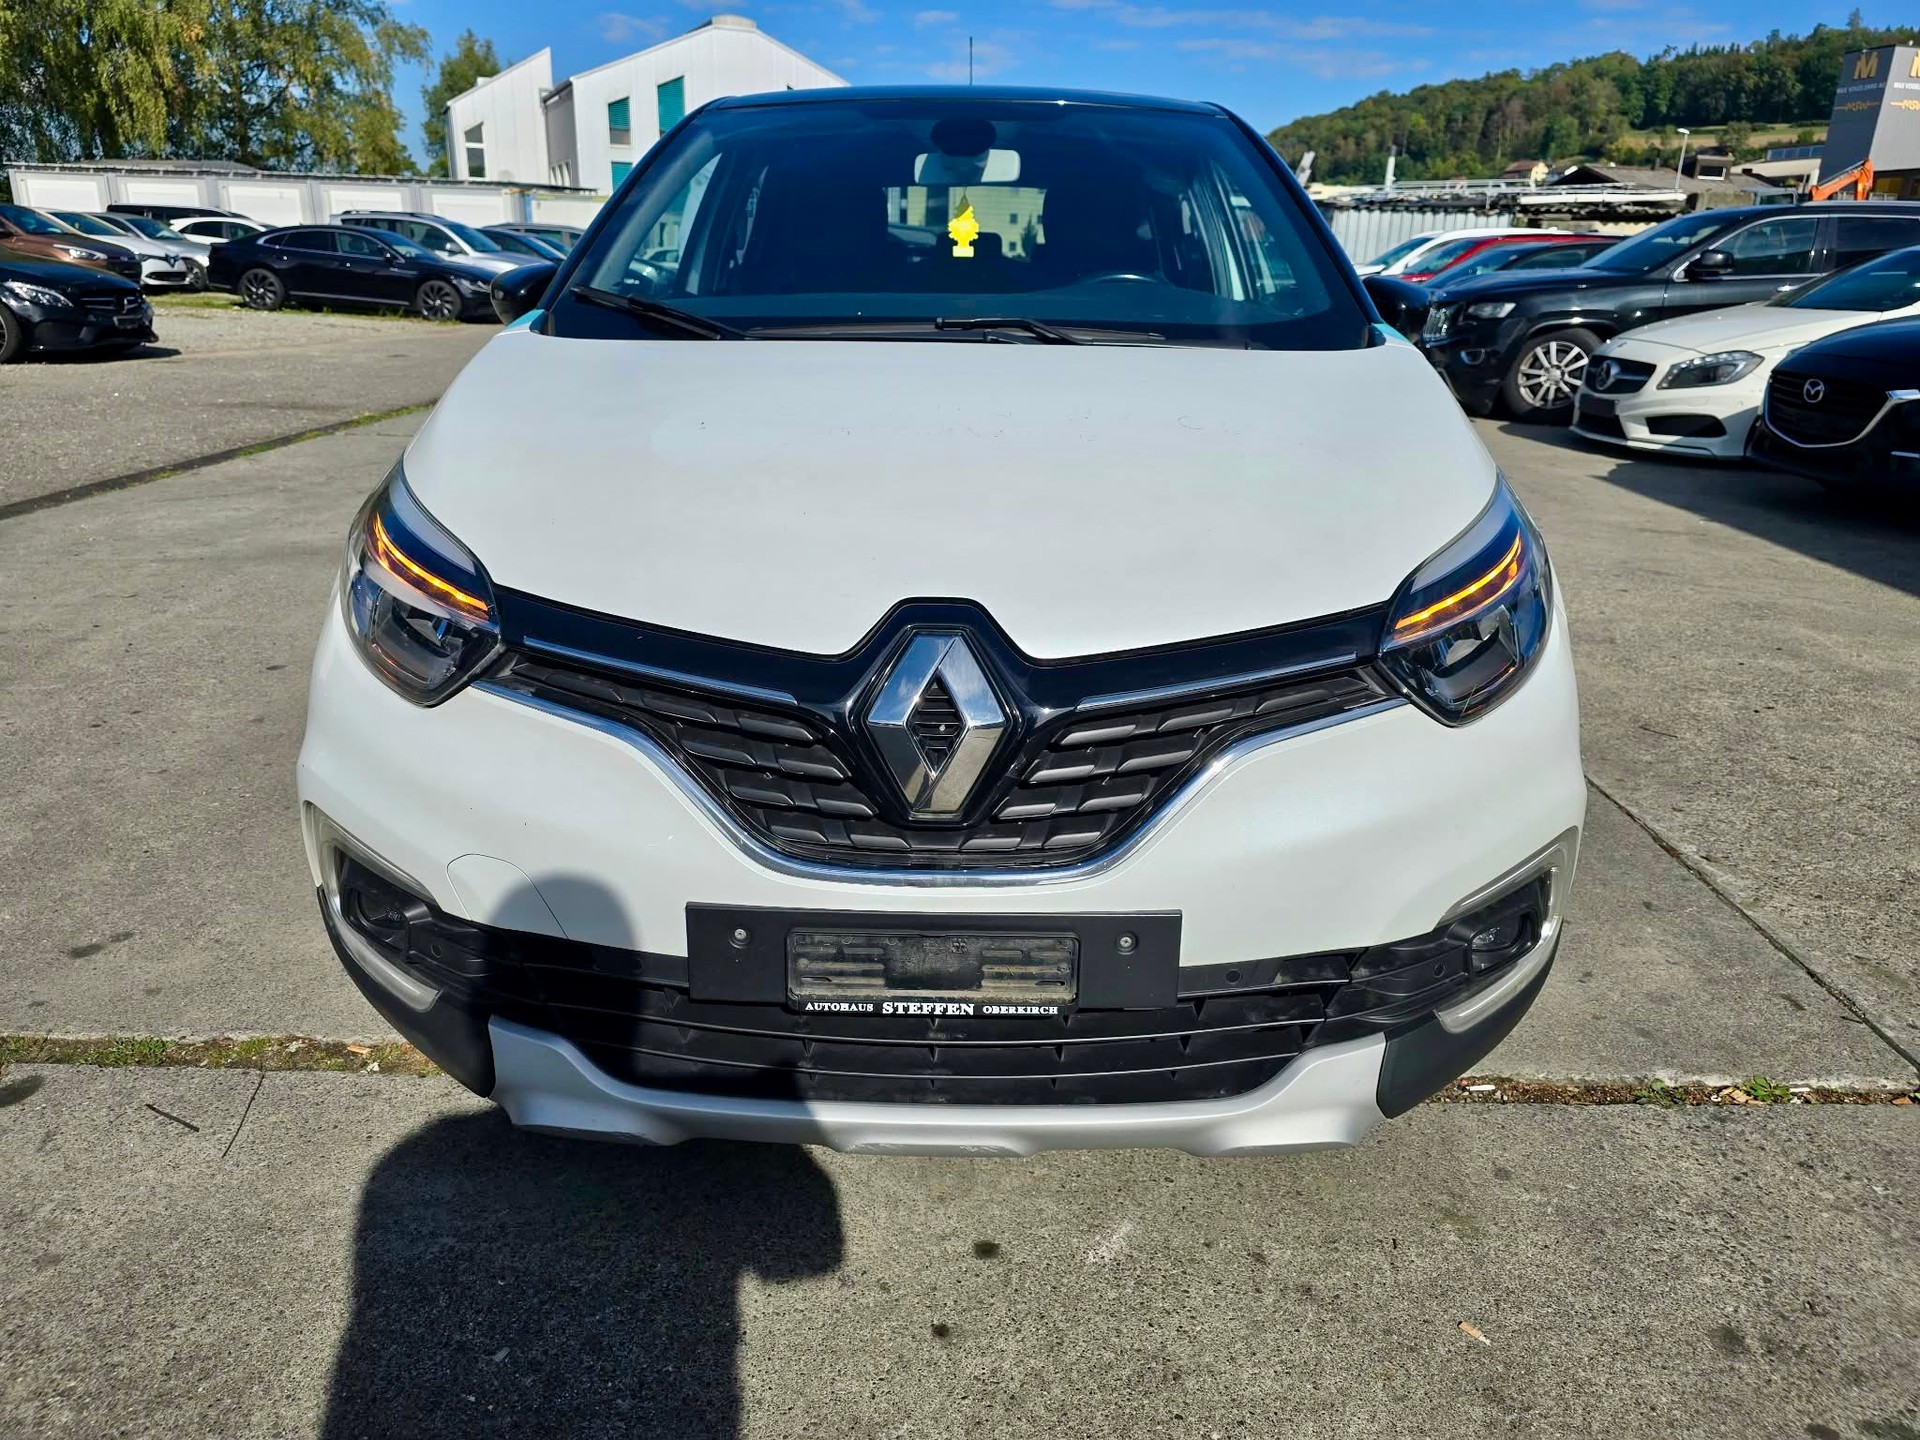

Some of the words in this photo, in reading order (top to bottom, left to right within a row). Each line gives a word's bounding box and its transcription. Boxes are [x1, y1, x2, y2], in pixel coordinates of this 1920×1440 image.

[1853, 52, 1879, 80] M
[804, 1002, 874, 1013] AUTOHAUS
[882, 1002, 975, 1016] STEFFEN
[982, 1005, 1059, 1016] OBERKIRCH
